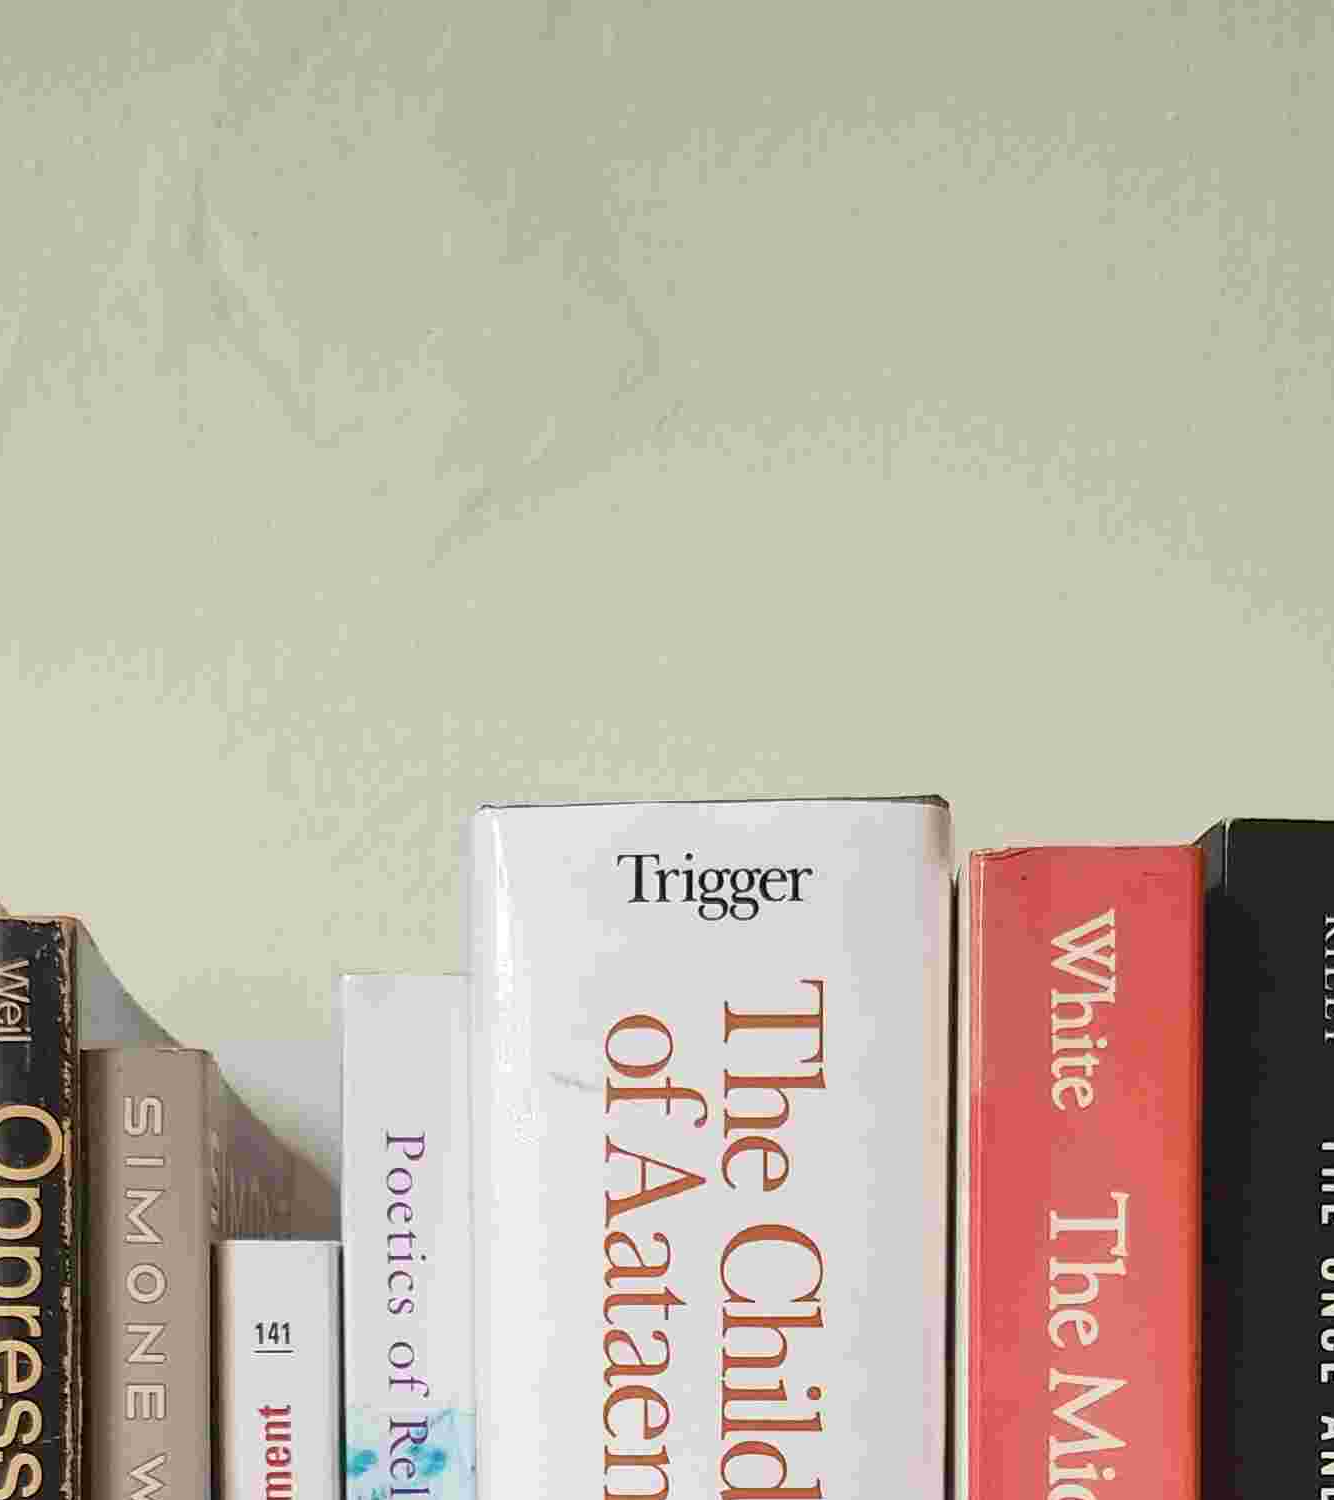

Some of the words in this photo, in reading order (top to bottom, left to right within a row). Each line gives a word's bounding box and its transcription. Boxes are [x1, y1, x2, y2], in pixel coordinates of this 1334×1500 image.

[617, 852, 813, 920] Trigger
[605, 1014, 707, 1129] of
[721, 979, 826, 1193] The
[1050, 908, 1115, 1111] White
[124, 1095, 165, 1424] SIMONE
[385, 1129, 426, 1316] Poetics
[1048, 1191, 1130, 1348] The
[254, 1322, 292, 1345] 141
[387, 1341, 429, 1398] of
